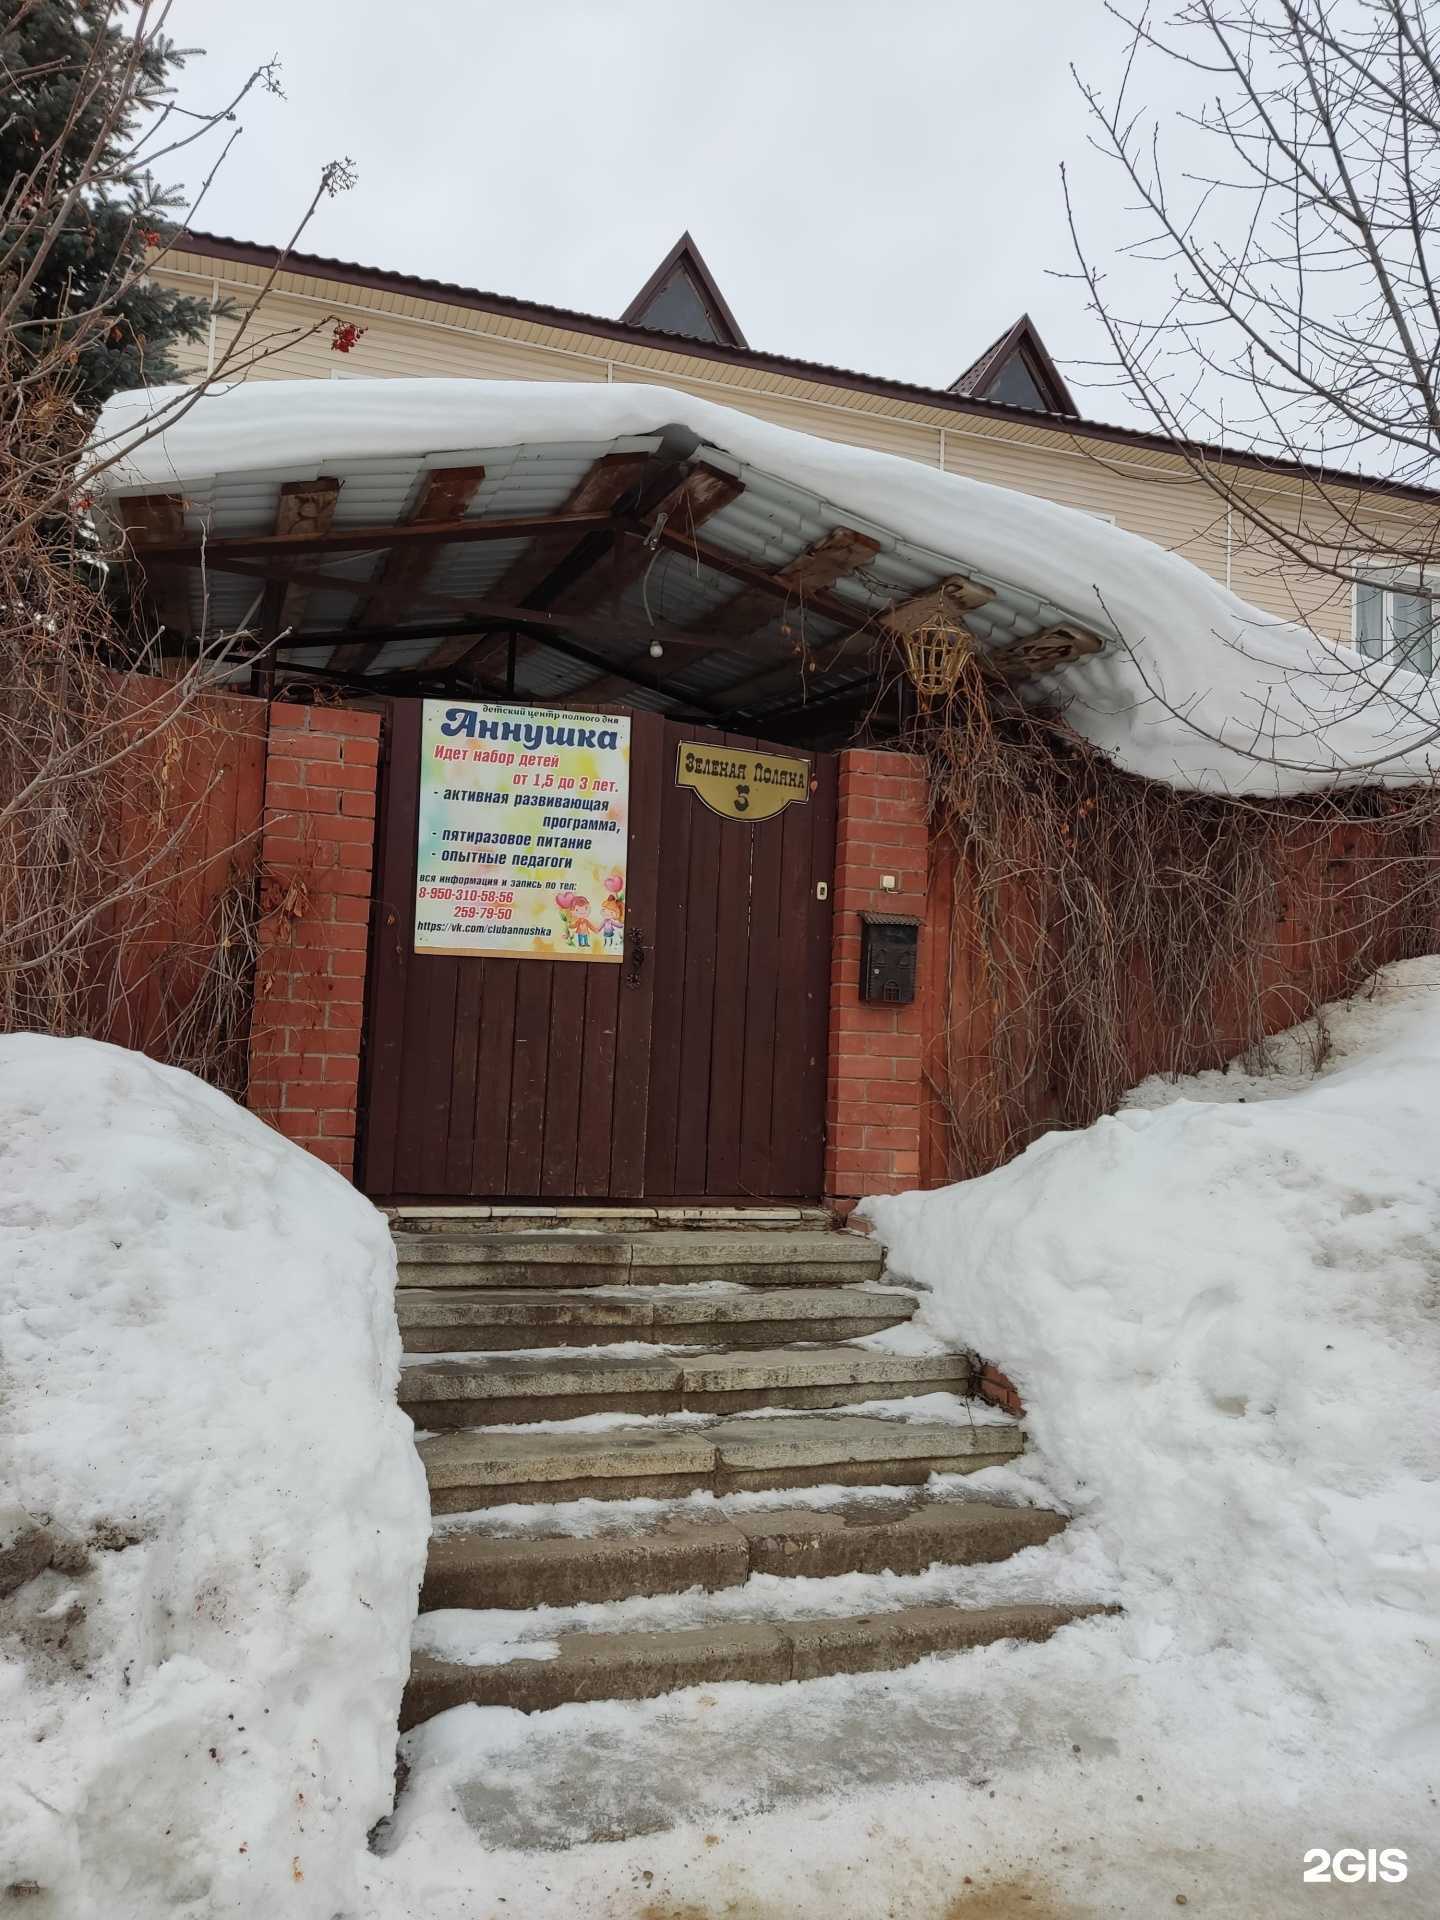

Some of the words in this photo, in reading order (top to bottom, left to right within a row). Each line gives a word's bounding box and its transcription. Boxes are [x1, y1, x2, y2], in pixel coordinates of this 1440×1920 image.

[483, 705, 525, 715] детский
[528, 710, 560, 720] центр
[562, 714, 600, 723] полного
[602, 716, 619, 724] дня
[441, 708, 618, 750] Аннушка
[434, 745, 468, 761] Идет
[473, 748, 514, 765] набор
[519, 753, 559, 768] детей
[513, 773, 528, 785] от
[533, 774, 553, 788] 1,5
[558, 777, 575, 789] до
[579, 777, 588, 789] 3
[593, 779, 618, 792] лет.
[443, 789, 508, 804] активная
[514, 793, 608, 811] развивающая
[543, 816, 620, 833] программа,
[442, 830, 531, 847] пятиразовое
[536, 836, 592, 850] питание
[441, 850, 506, 865] опытные
[512, 854, 572, 869] педагоги
[439, 876, 498, 886] информация
[510, 880, 542, 888] запись
[454, 907, 512, 919] 259-79-50
[417, 922, 551, 936] https://vk.com/clubannushka
